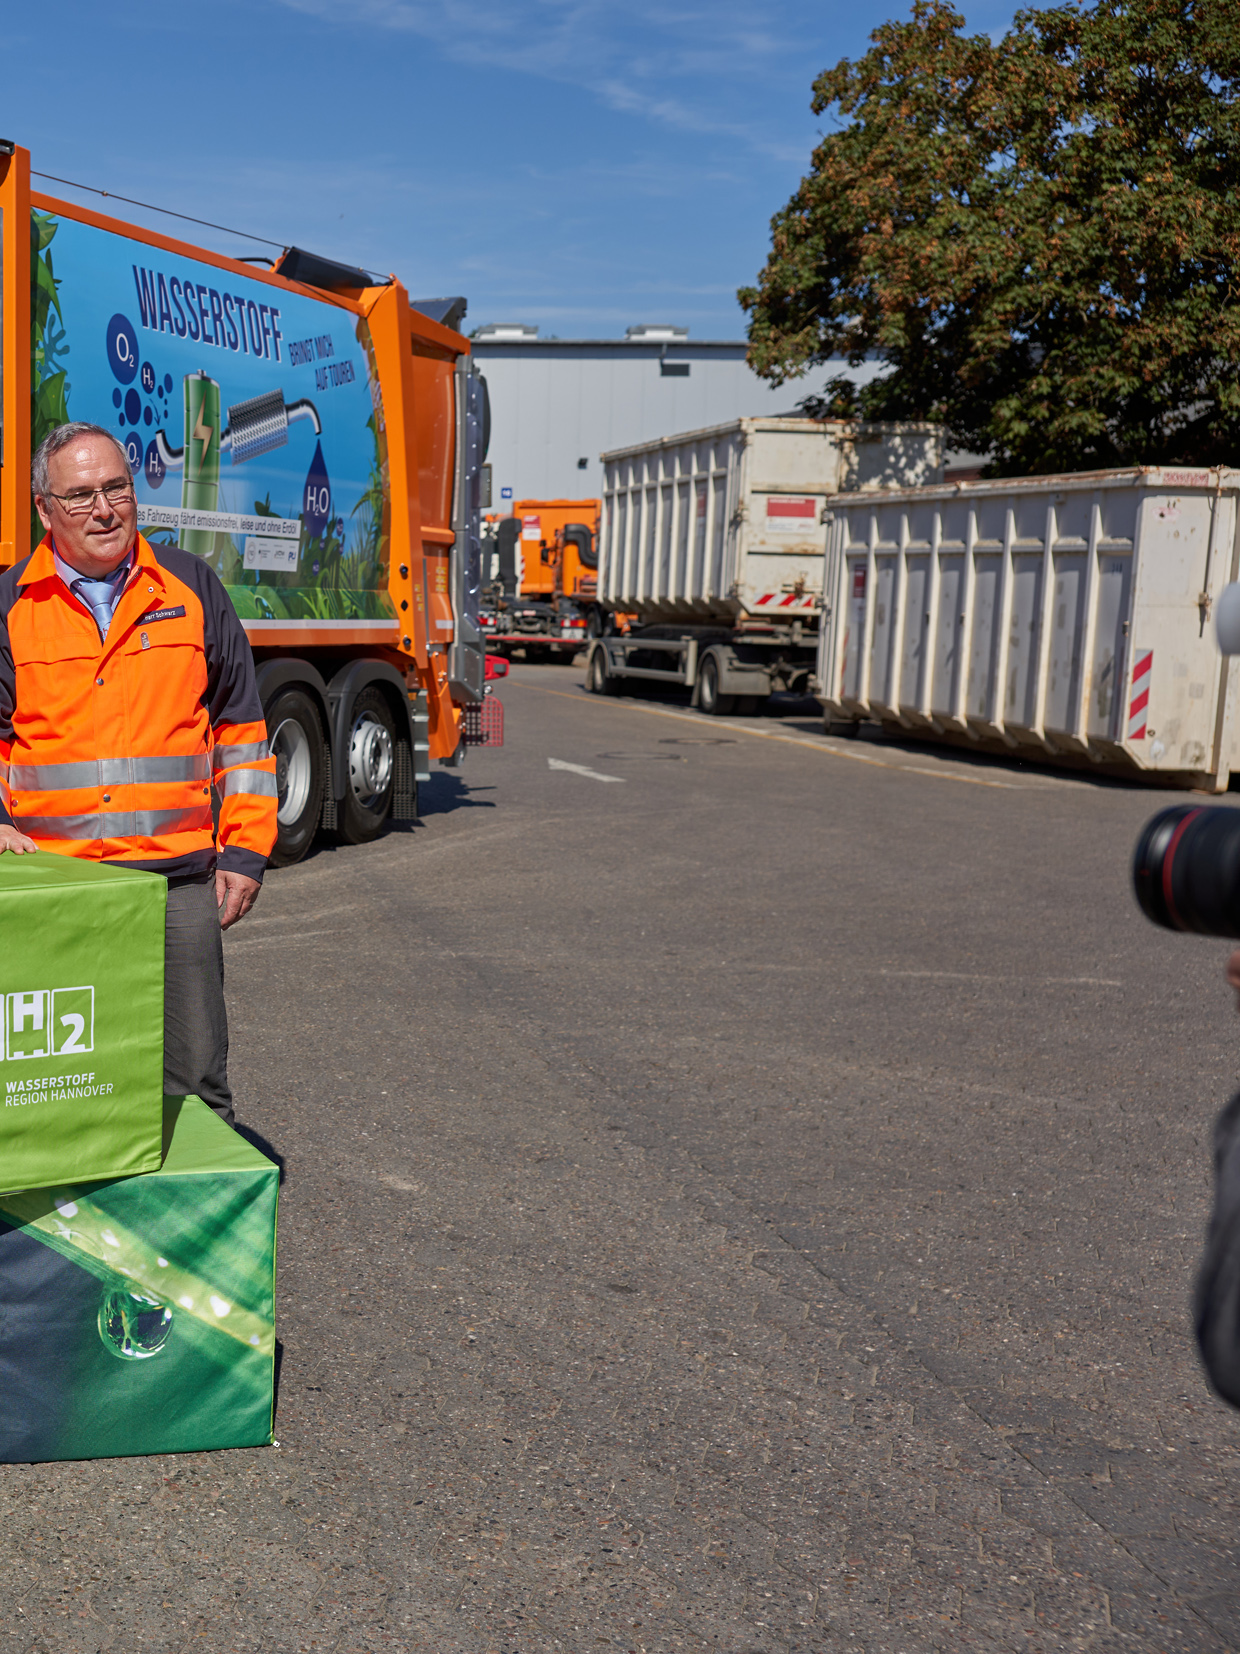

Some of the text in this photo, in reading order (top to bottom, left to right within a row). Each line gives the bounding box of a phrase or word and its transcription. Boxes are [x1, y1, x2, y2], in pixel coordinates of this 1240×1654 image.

[132, 264, 284, 363] WASSERSTOFF
[289, 334, 334, 366] BRINGT MICH
[142, 368, 154, 389] H2
[315, 360, 356, 391] AUF TOUREN
[149, 452, 162, 477] H2
[306, 485, 330, 517] H2O
[147, 508, 179, 526] Fahrzeug
[180, 511, 196, 527] fährt
[240, 517, 254, 529] leise
[254, 520, 267, 531] und
[267, 521, 282, 533] ohne
[282, 522, 298, 535] Erdöl
[5, 1083, 114, 1107] REGION HANNOVER
[6, 1072, 95, 1093] WASSERSTOFF
